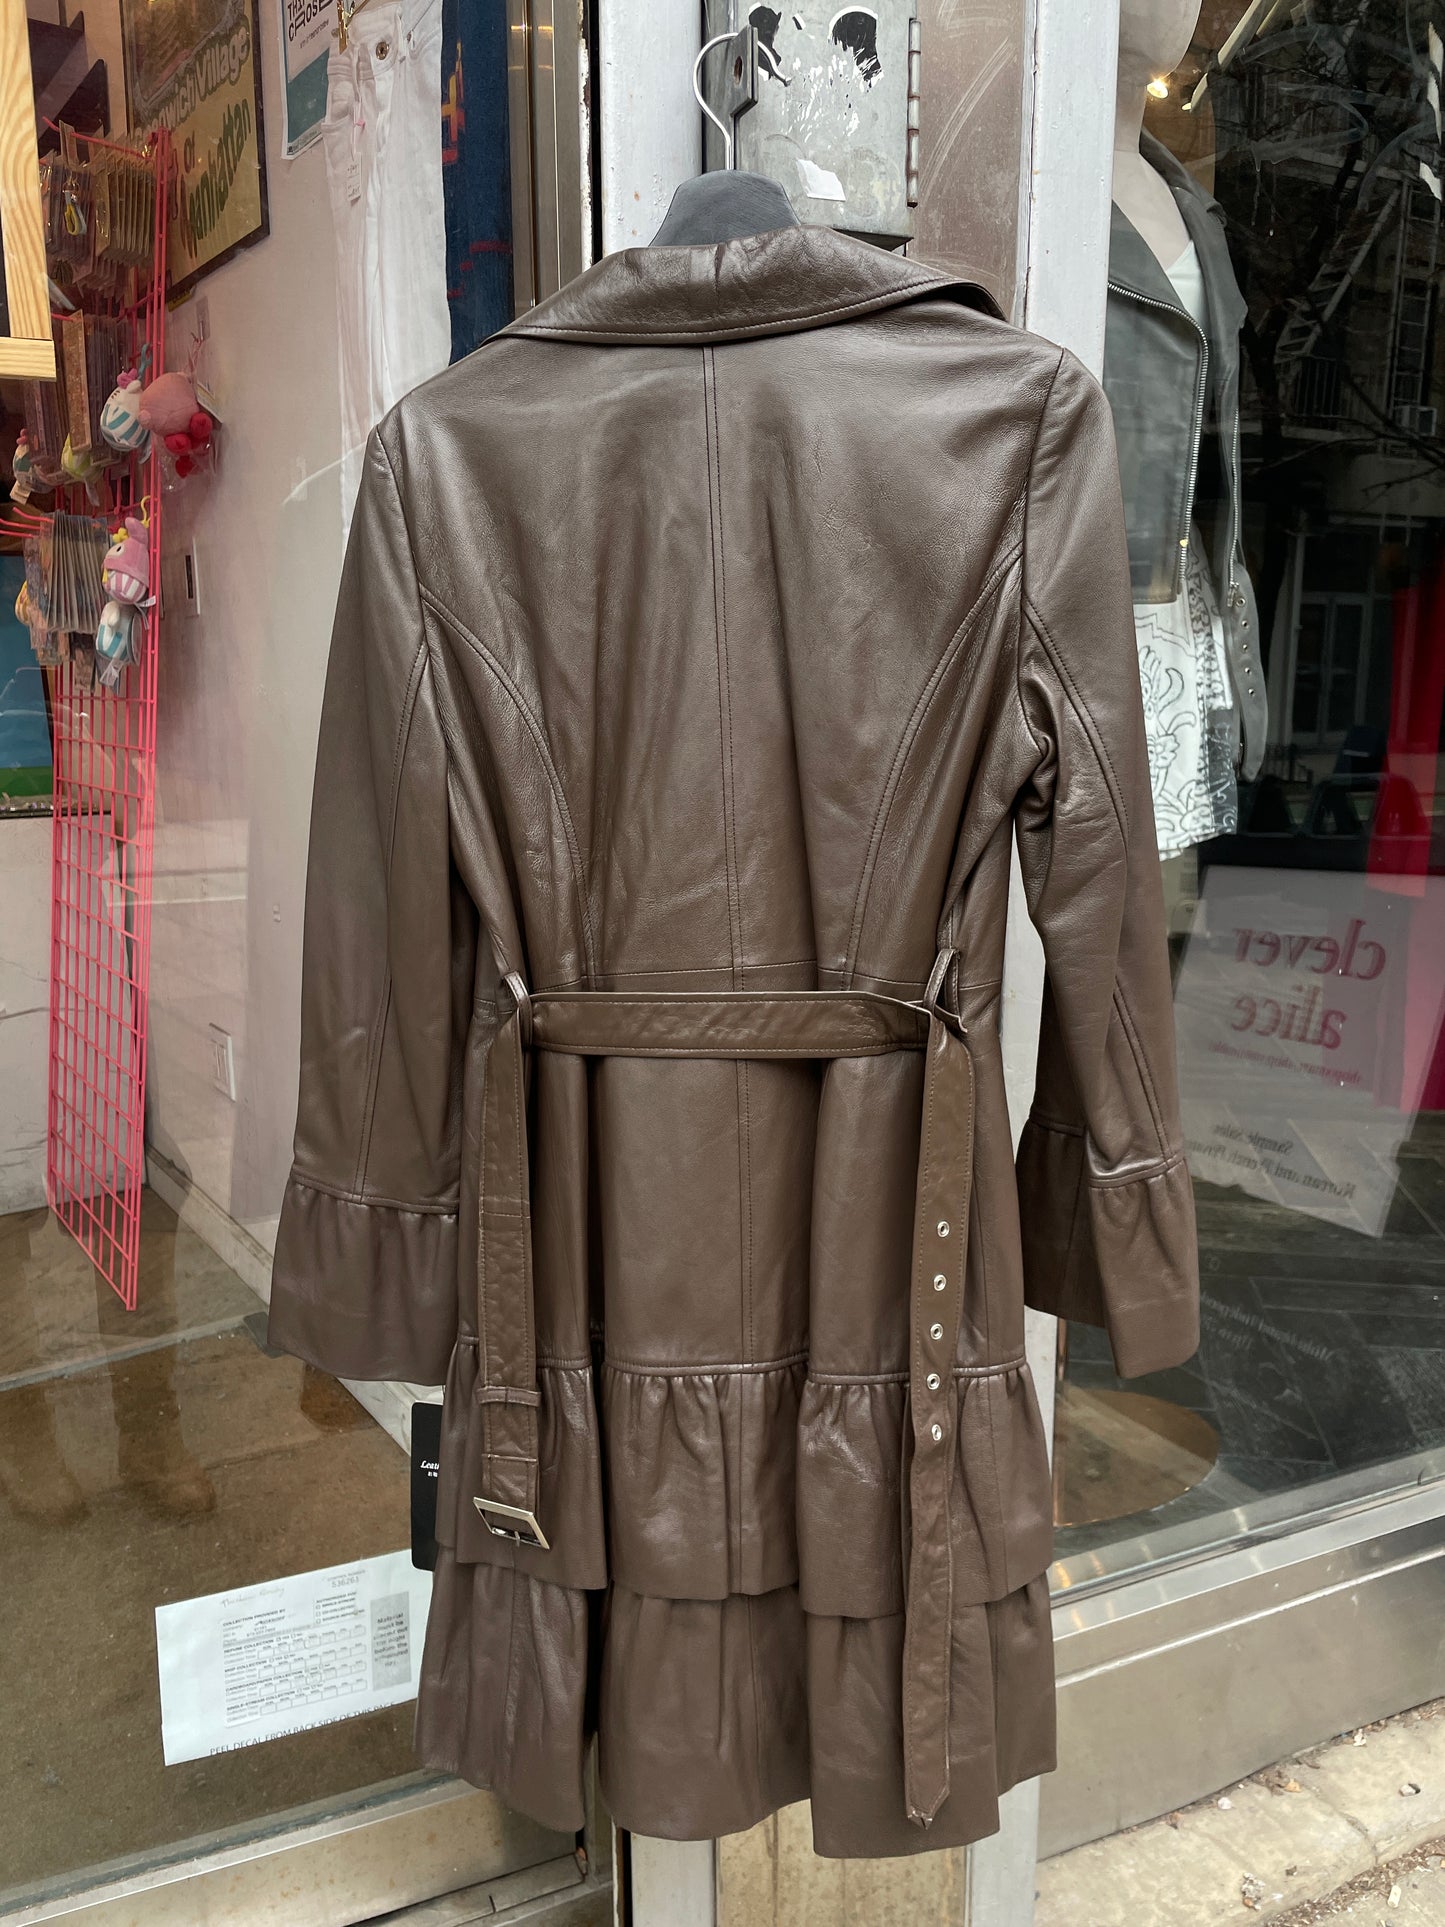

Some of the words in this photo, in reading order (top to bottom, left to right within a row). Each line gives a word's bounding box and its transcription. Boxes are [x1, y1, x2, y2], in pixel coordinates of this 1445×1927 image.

[195, 24, 249, 101] Village
[180, 98, 251, 258] Manhattan
[210, 1745, 230, 1756] PEEL
[233, 1737, 262, 1750] DECAL
[265, 1729, 291, 1742] FROM
[293, 1722, 316, 1734] BACK
[318, 1716, 338, 1727] SIDE
